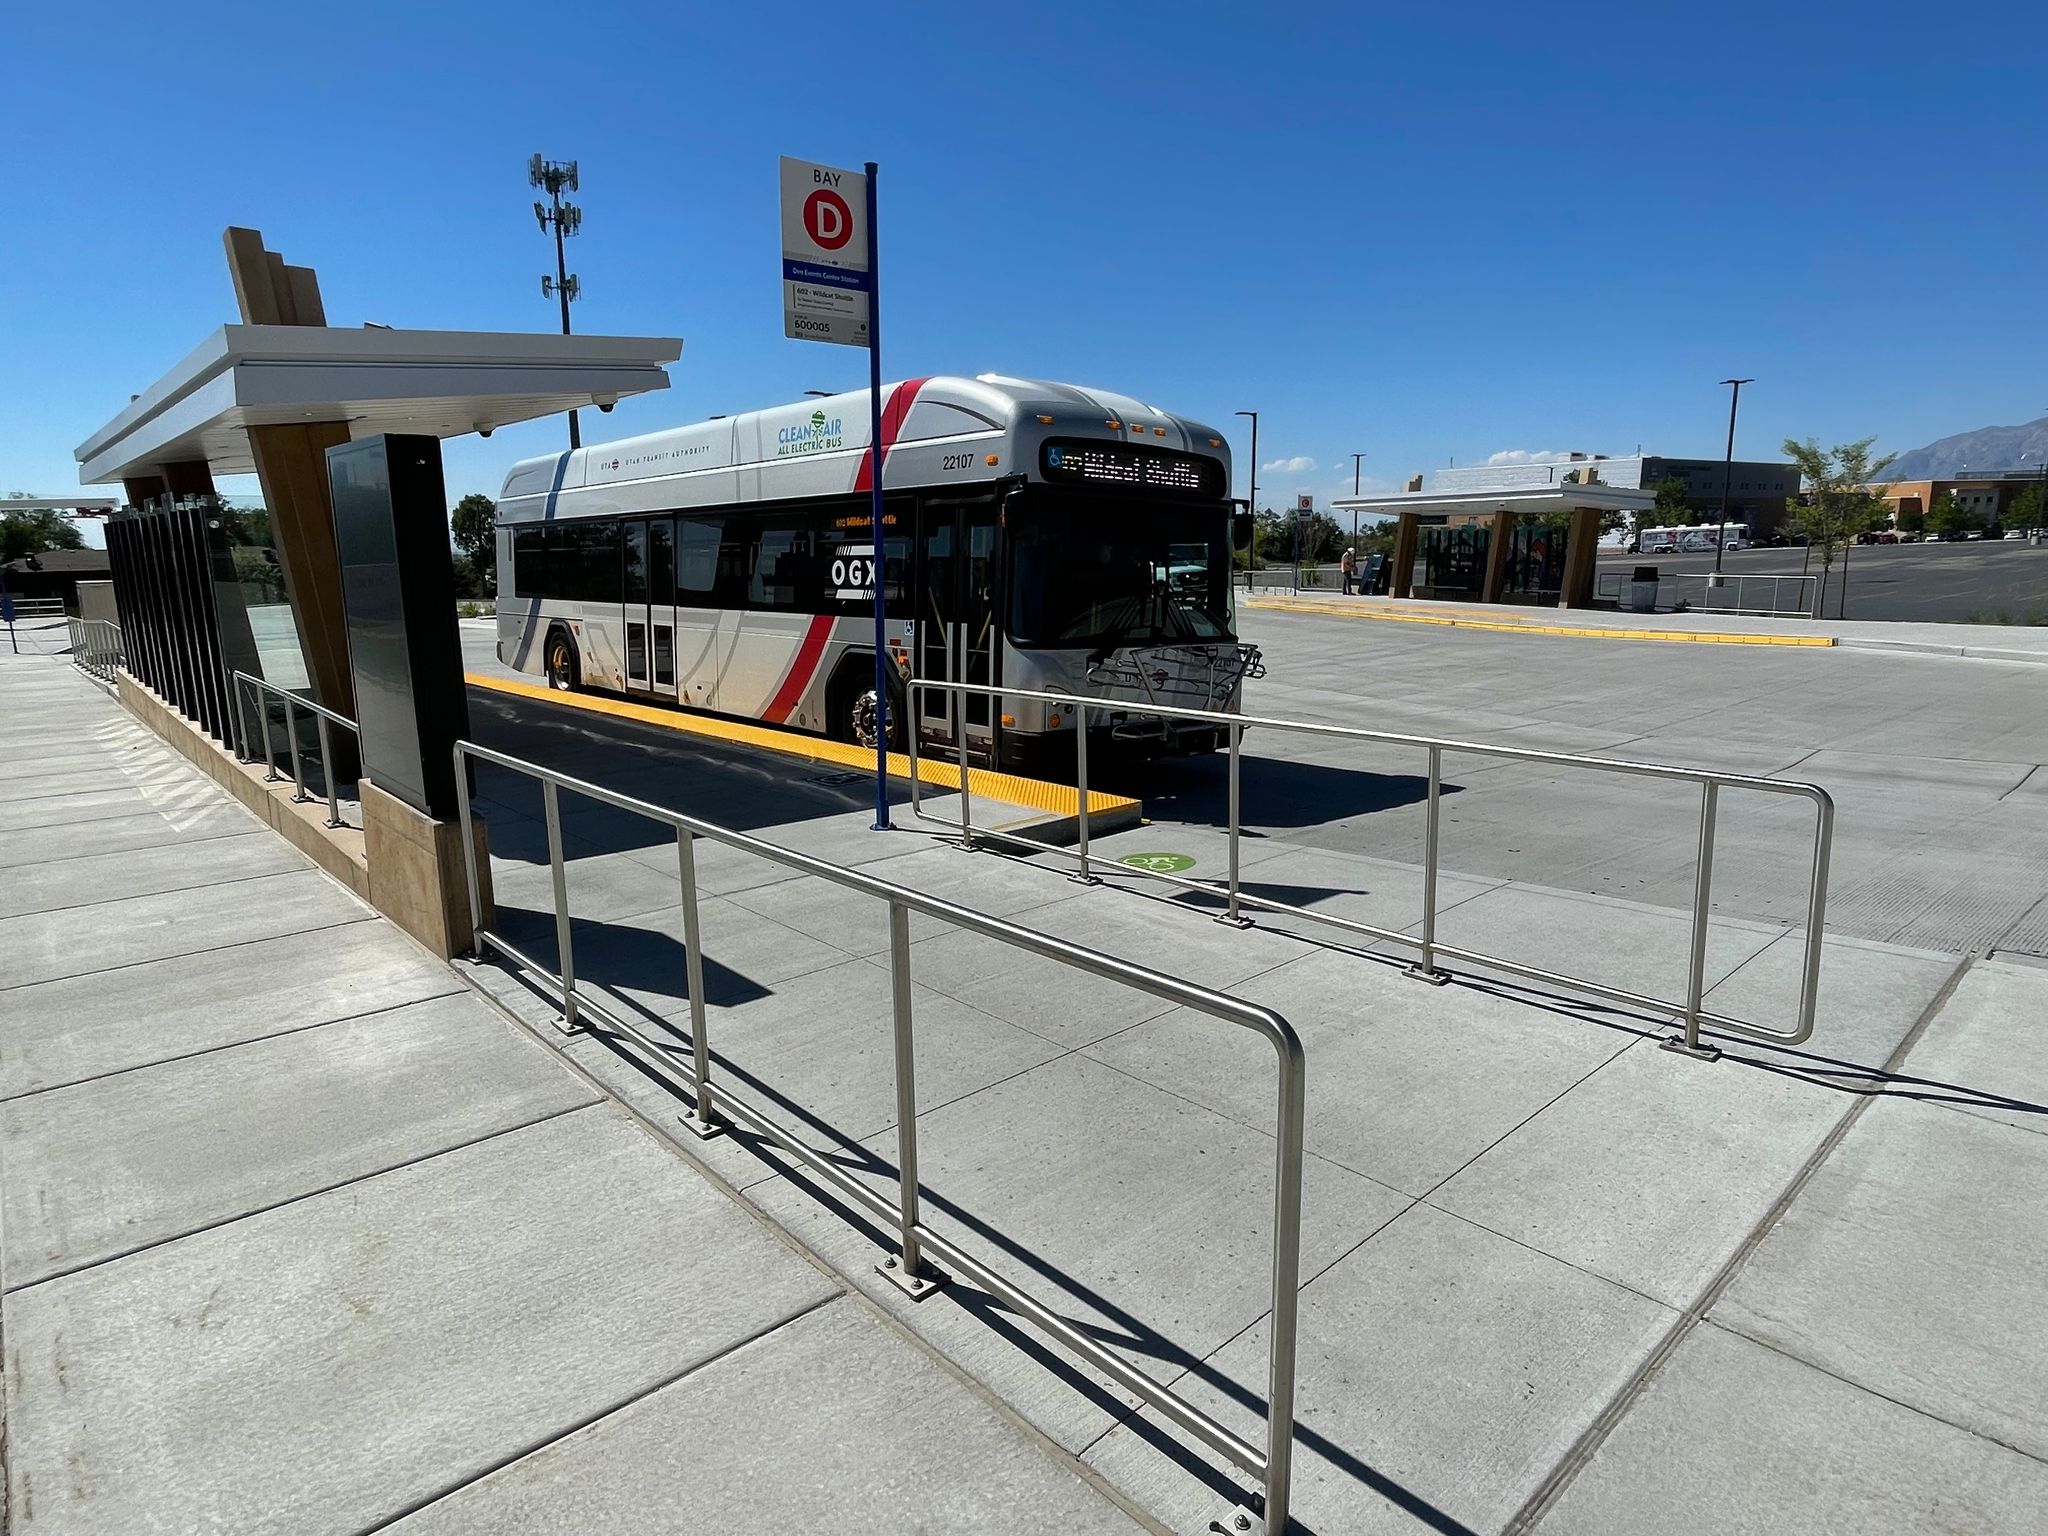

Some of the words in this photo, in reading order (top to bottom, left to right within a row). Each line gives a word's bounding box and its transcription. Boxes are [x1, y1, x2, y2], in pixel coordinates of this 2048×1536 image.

[814, 169, 841, 187] BAY
[817, 201, 842, 238] D
[823, 272, 840, 281] Center
[812, 289, 834, 299] Wildcat
[794, 320, 830, 332] 600005
[779, 424, 811, 443] CLEAN
[823, 419, 842, 437] AIR
[672, 446, 709, 457] AUTHORITY
[778, 445, 789, 455] ALL
[791, 440, 824, 453] ELECTRIC
[826, 436, 842, 448] BUS
[943, 454, 974, 470] 22107
[832, 560, 875, 586] OGX
